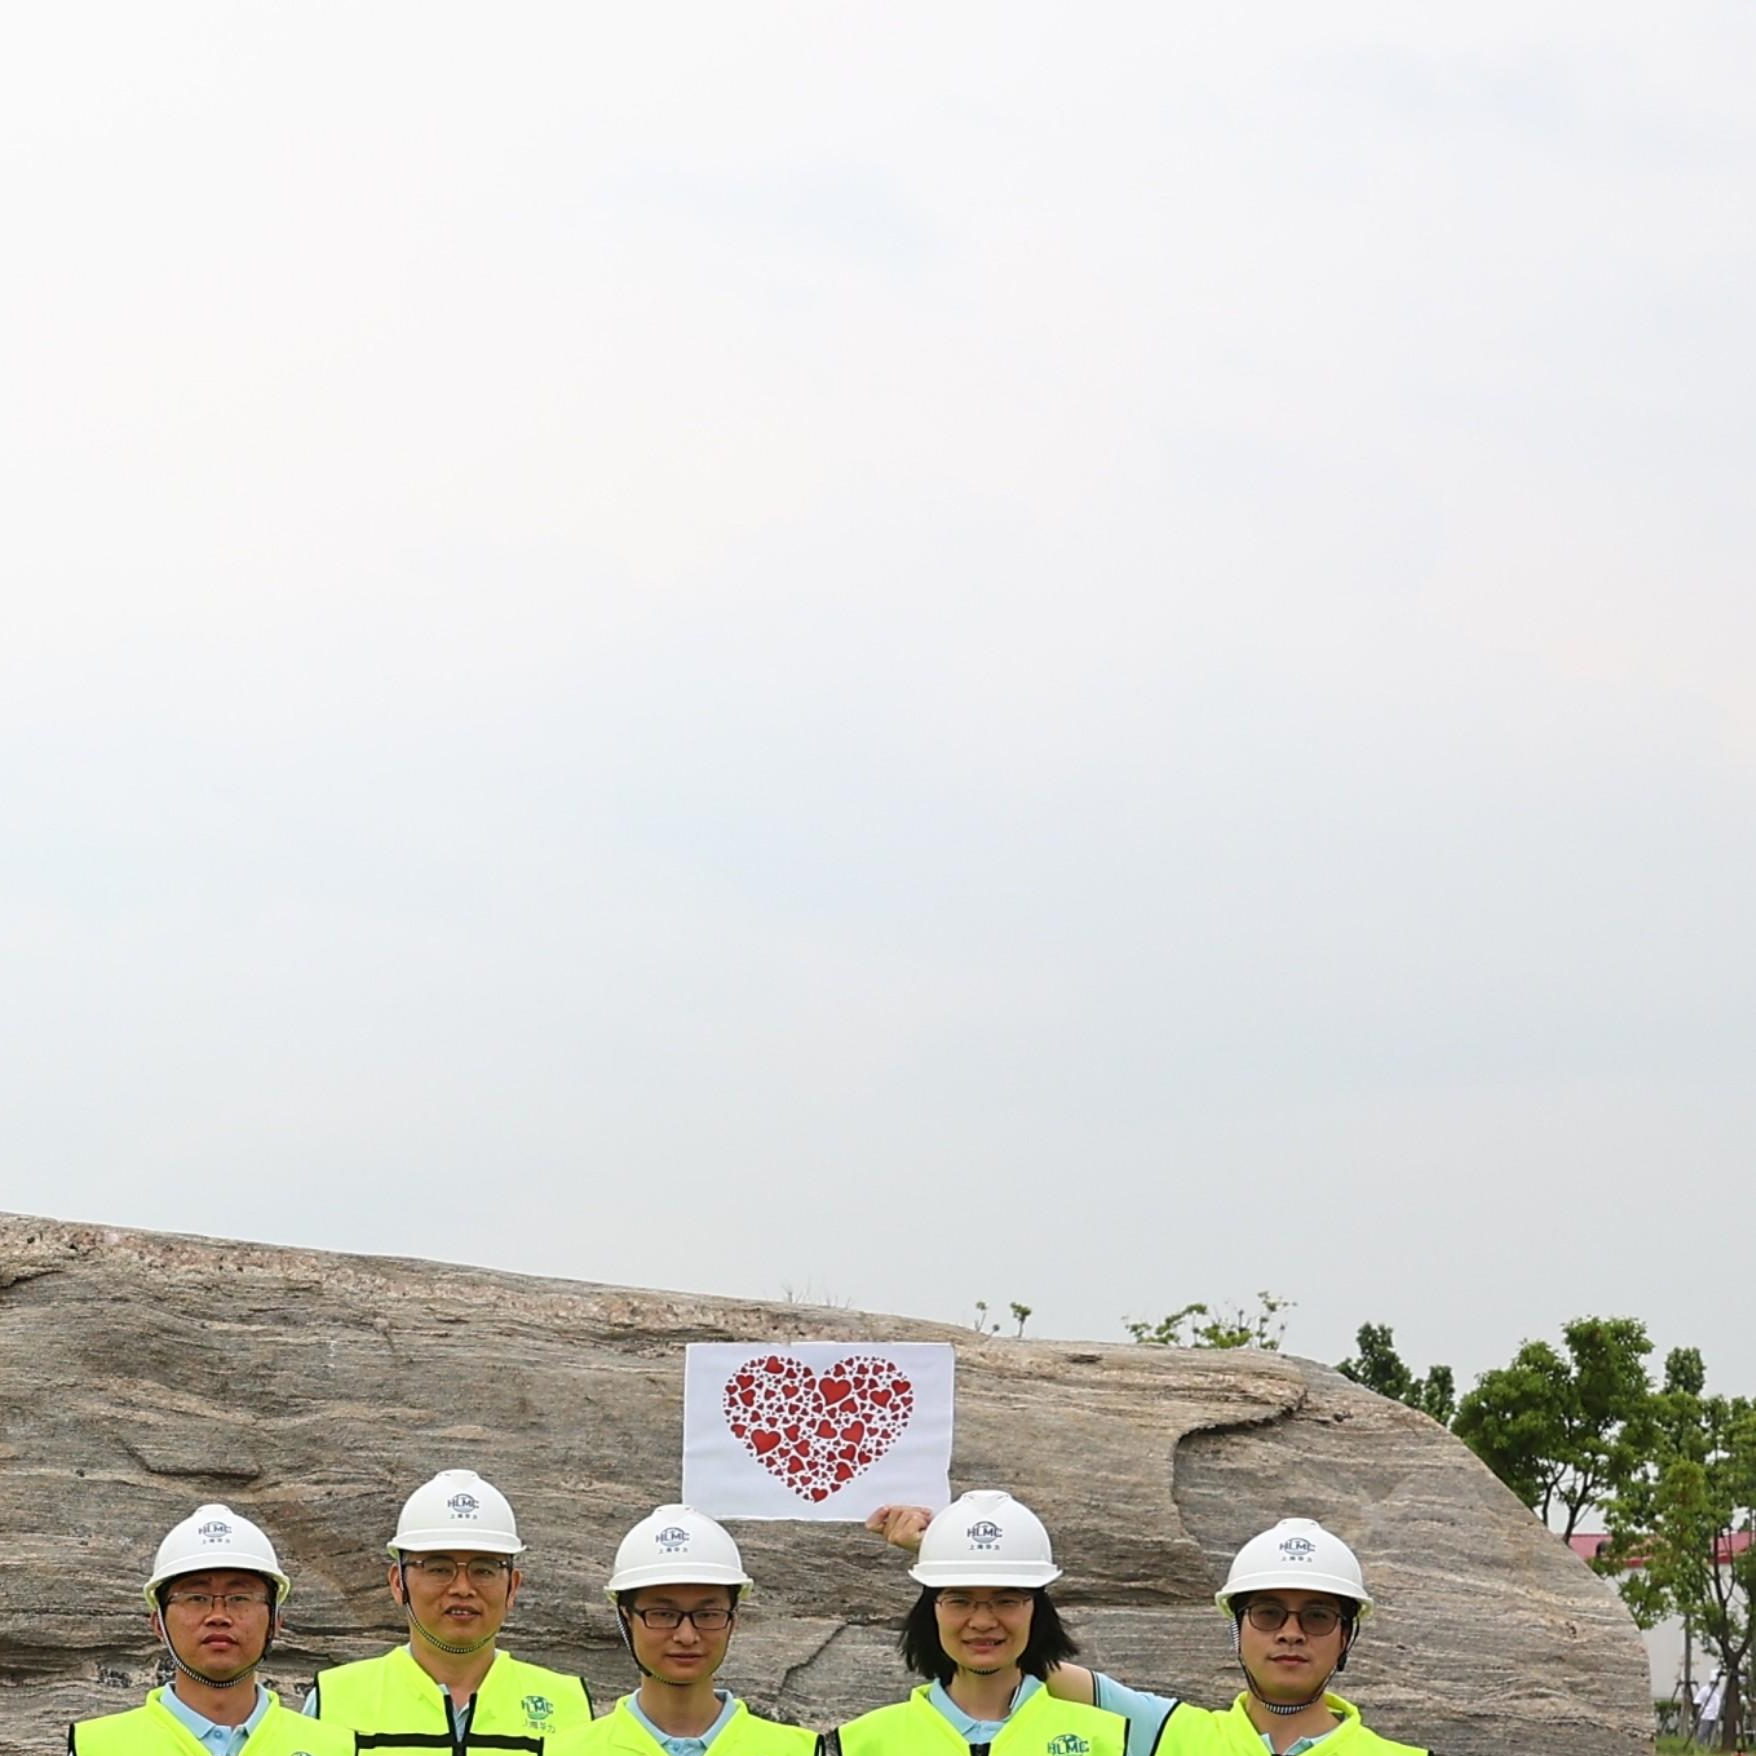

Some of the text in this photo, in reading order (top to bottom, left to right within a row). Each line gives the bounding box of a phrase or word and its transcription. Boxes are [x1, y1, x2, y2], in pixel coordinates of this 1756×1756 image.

[448, 1498, 479, 1509] HLMC
[656, 1532, 690, 1542] HLMC
[967, 1527, 1003, 1538] HLMC
[1280, 1544, 1316, 1553] HLMC
[1048, 1741, 1089, 1754] HLMC
